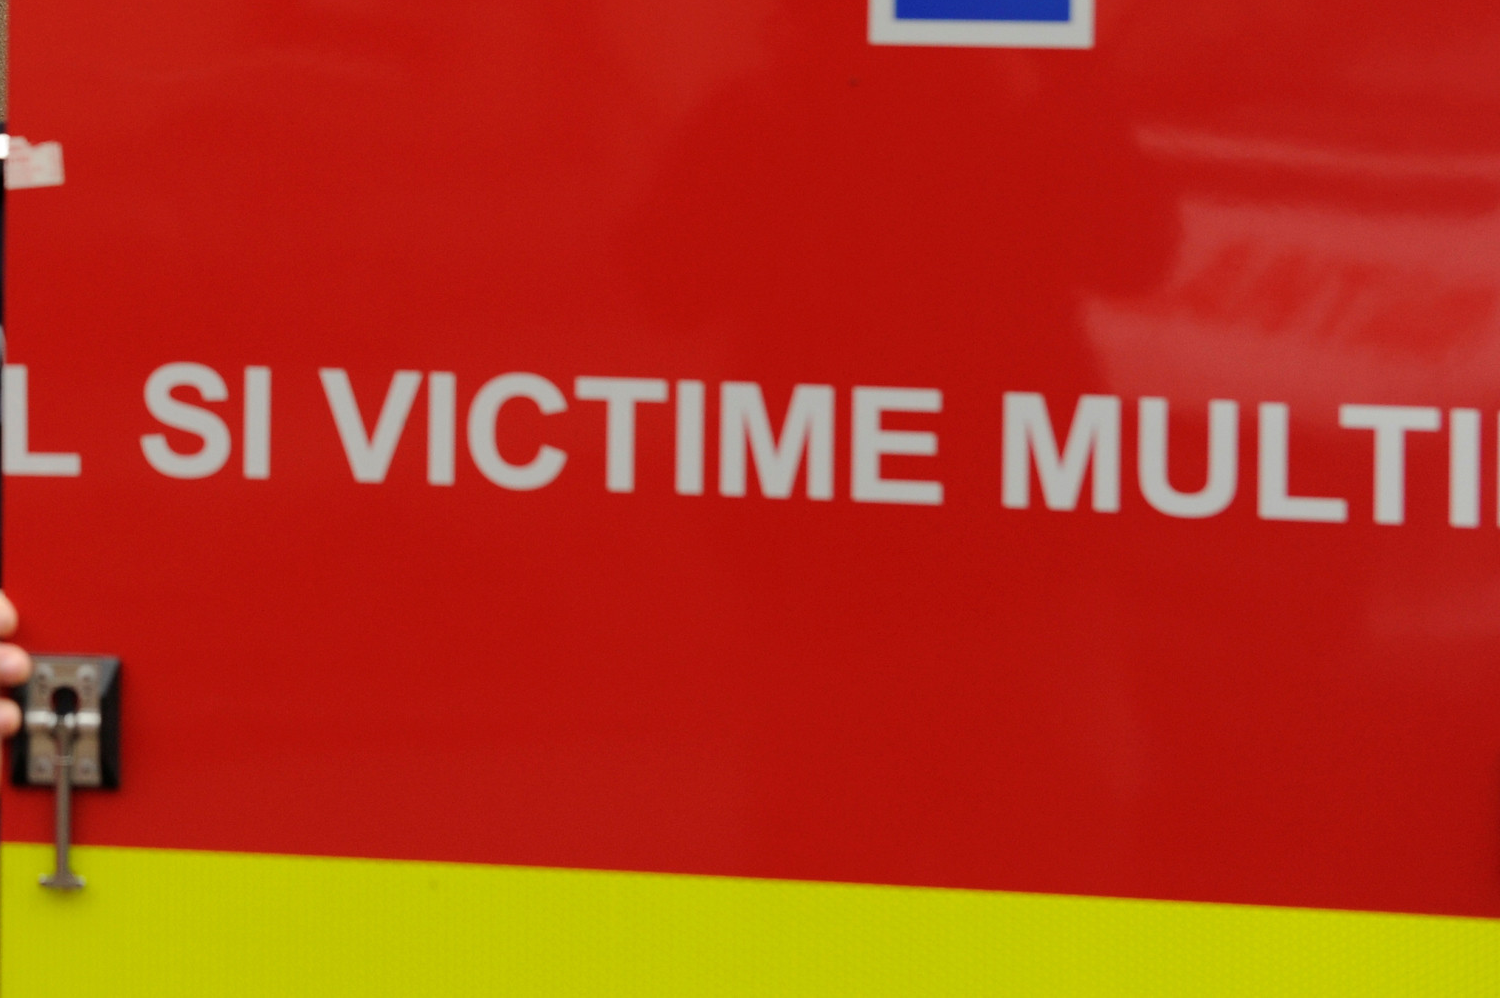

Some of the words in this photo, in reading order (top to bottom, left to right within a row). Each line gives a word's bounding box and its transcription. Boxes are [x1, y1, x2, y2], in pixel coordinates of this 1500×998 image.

[140, 361, 272, 480] SI
[319, 367, 944, 506] VICTIME
[1002, 390, 1500, 529] MULTI
